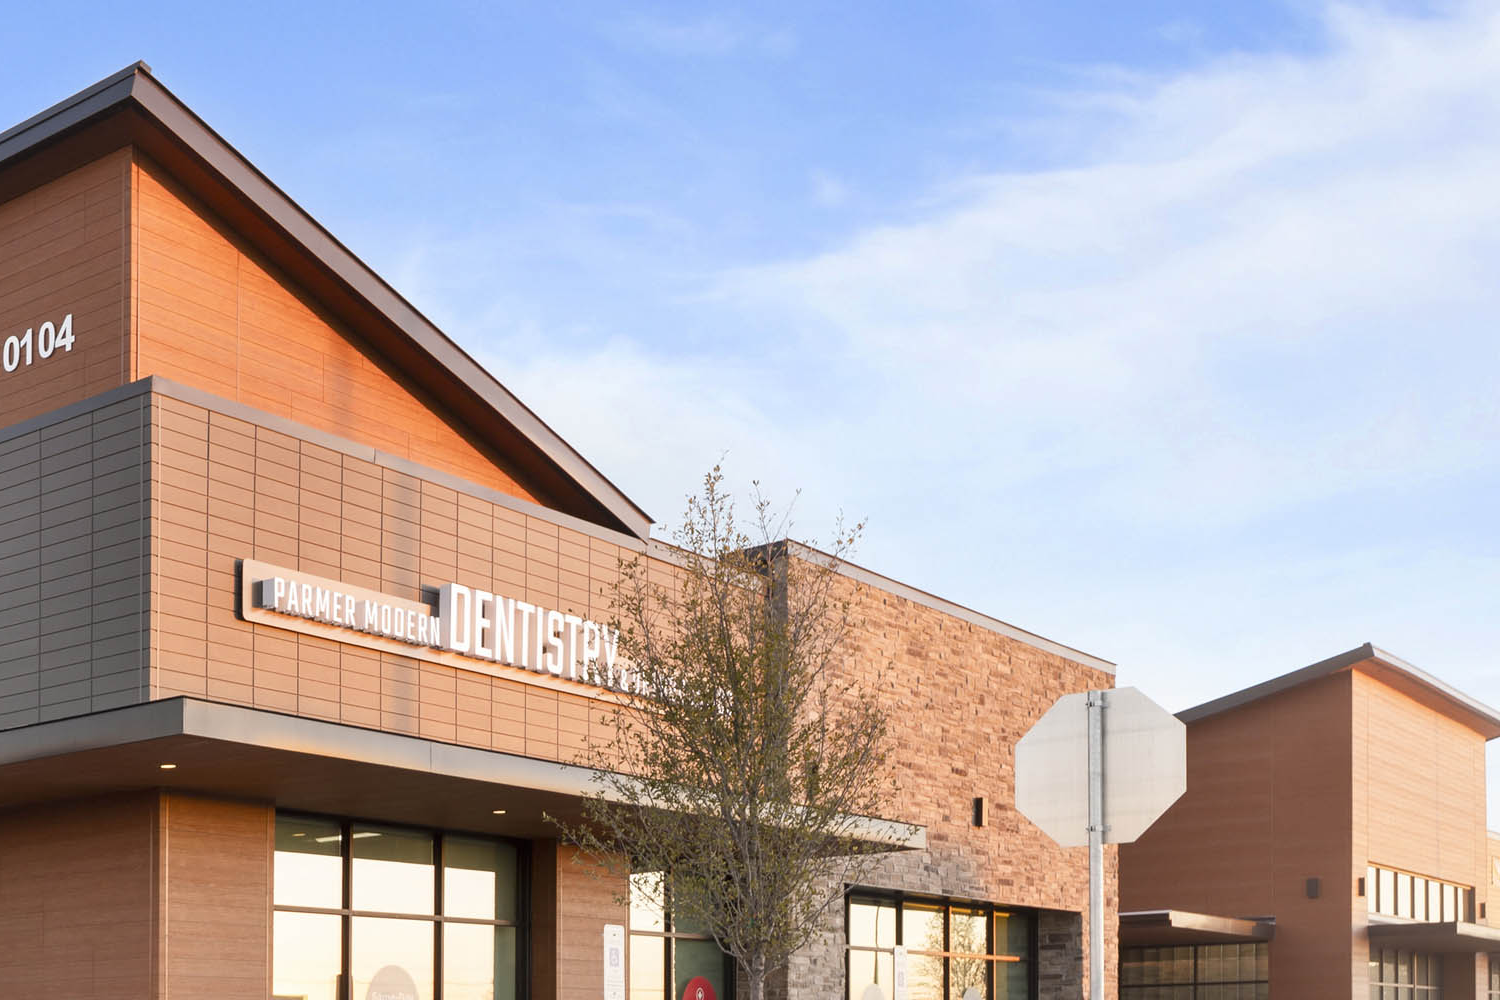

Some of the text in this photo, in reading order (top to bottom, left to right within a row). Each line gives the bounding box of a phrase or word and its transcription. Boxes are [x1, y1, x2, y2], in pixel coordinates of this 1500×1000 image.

[274, 577, 356, 627] PARMER
[364, 599, 440, 646] MODERN
[447, 582, 619, 687] DENTISTRY
